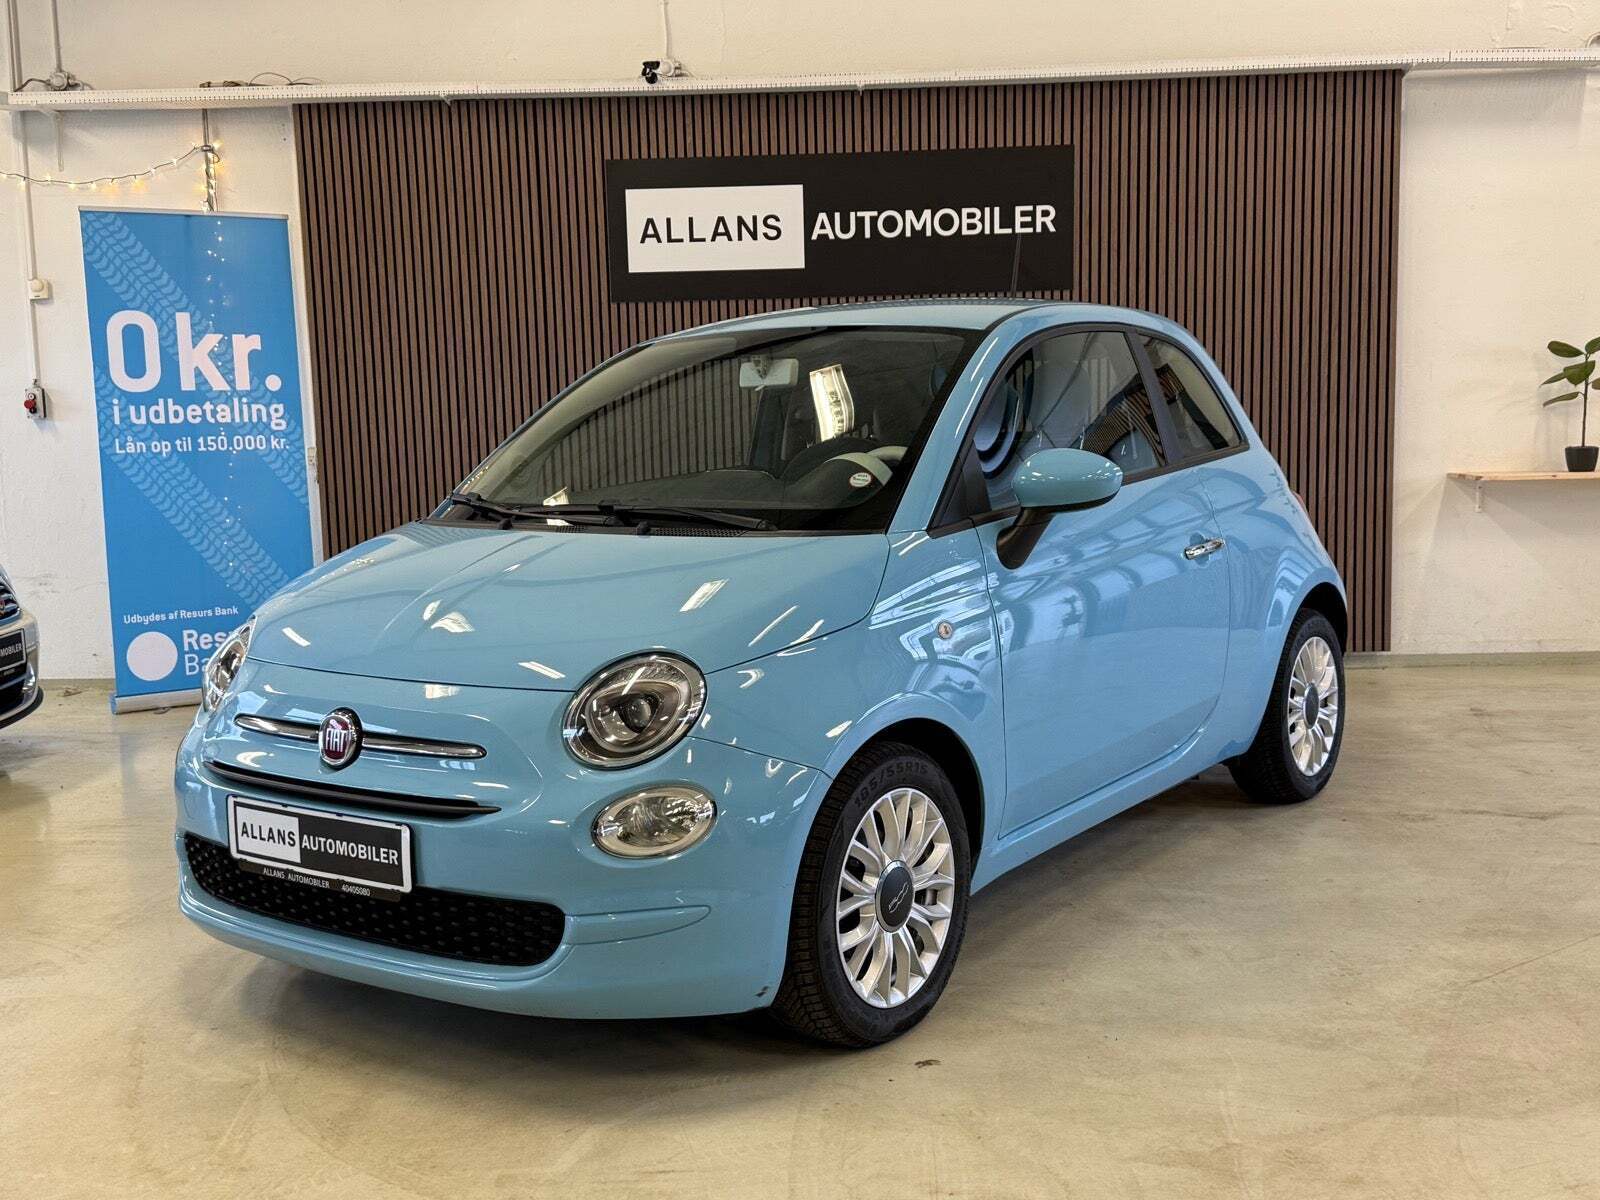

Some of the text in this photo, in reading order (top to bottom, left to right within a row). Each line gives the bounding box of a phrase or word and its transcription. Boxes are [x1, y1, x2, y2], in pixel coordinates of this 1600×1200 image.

[640, 204, 1057, 244] ALLANS AUTOMOBILER
[106, 310, 282, 392] 0 kr.
[112, 398, 287, 431] i udbetaling
[115, 435, 289, 456] Lån op til 150.000 kr.
[124, 605, 239, 625] Udbydes af Resurs Bank
[325, 728, 349, 752] FIAT
[241, 822, 399, 866] ALLANS AUTOMOBILER
[262, 867, 286, 879] ALLANS
[287, 872, 330, 889] AUTOMOBILER
